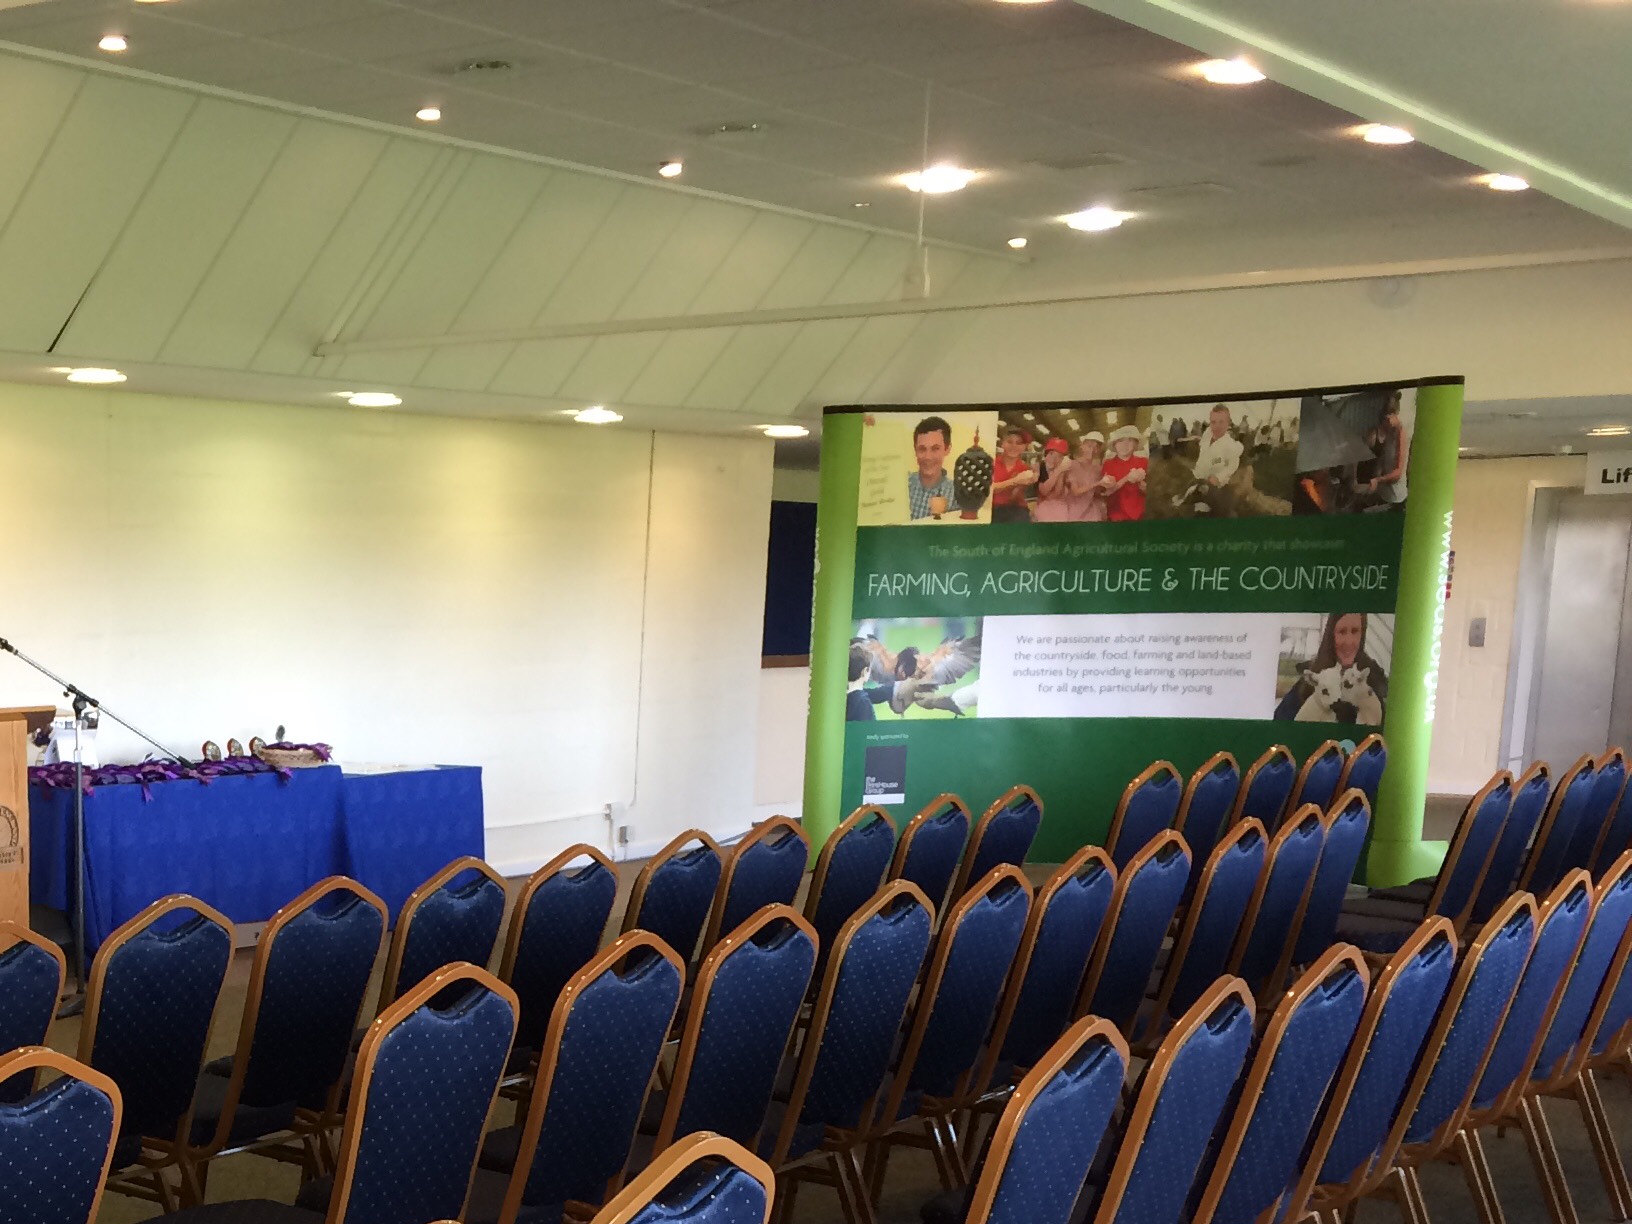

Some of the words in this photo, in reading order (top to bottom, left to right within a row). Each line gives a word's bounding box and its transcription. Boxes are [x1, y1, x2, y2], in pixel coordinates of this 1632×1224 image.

[1601, 467, 1632, 483] Lif
[928, 544, 950, 557] The
[952, 544, 989, 557] South
[991, 543, 1005, 556] of
[1009, 542, 1059, 558] England
[1063, 542, 1138, 558] Agricultural
[1142, 541, 1190, 555] Society
[1216, 539, 1260, 554] charity
[868, 571, 971, 598] FARMING,
[980, 568, 1152, 594] AGRICULTURE
[1161, 568, 1179, 591] &
[1189, 567, 1231, 591] THE
[1239, 565, 1389, 591] COUNTRYSIDE
[1016, 635, 1033, 644] We
[1036, 636, 1052, 644] are
[1055, 635, 1110, 646] passionate
[1114, 633, 1144, 644] about
[1148, 634, 1181, 645] raising
[1183, 634, 1233, 643] awareness
[1236, 633, 1248, 642] of
[1014, 651, 1031, 660] the
[1133, 649, 1174, 661] farming
[1176, 649, 1195, 659] and
[1197, 649, 1252, 660] land-based
[1013, 667, 1063, 677] industries
[1066, 666, 1079, 678] by
[1082, 666, 1131, 678] providing
[1134, 666, 1175, 678] learning
[1178, 667, 1246, 679] opportunities
[1038, 682, 1053, 692] for
[1056, 682, 1068, 692] all
[1099, 683, 1158, 695] particularly
[1162, 683, 1179, 692] the
